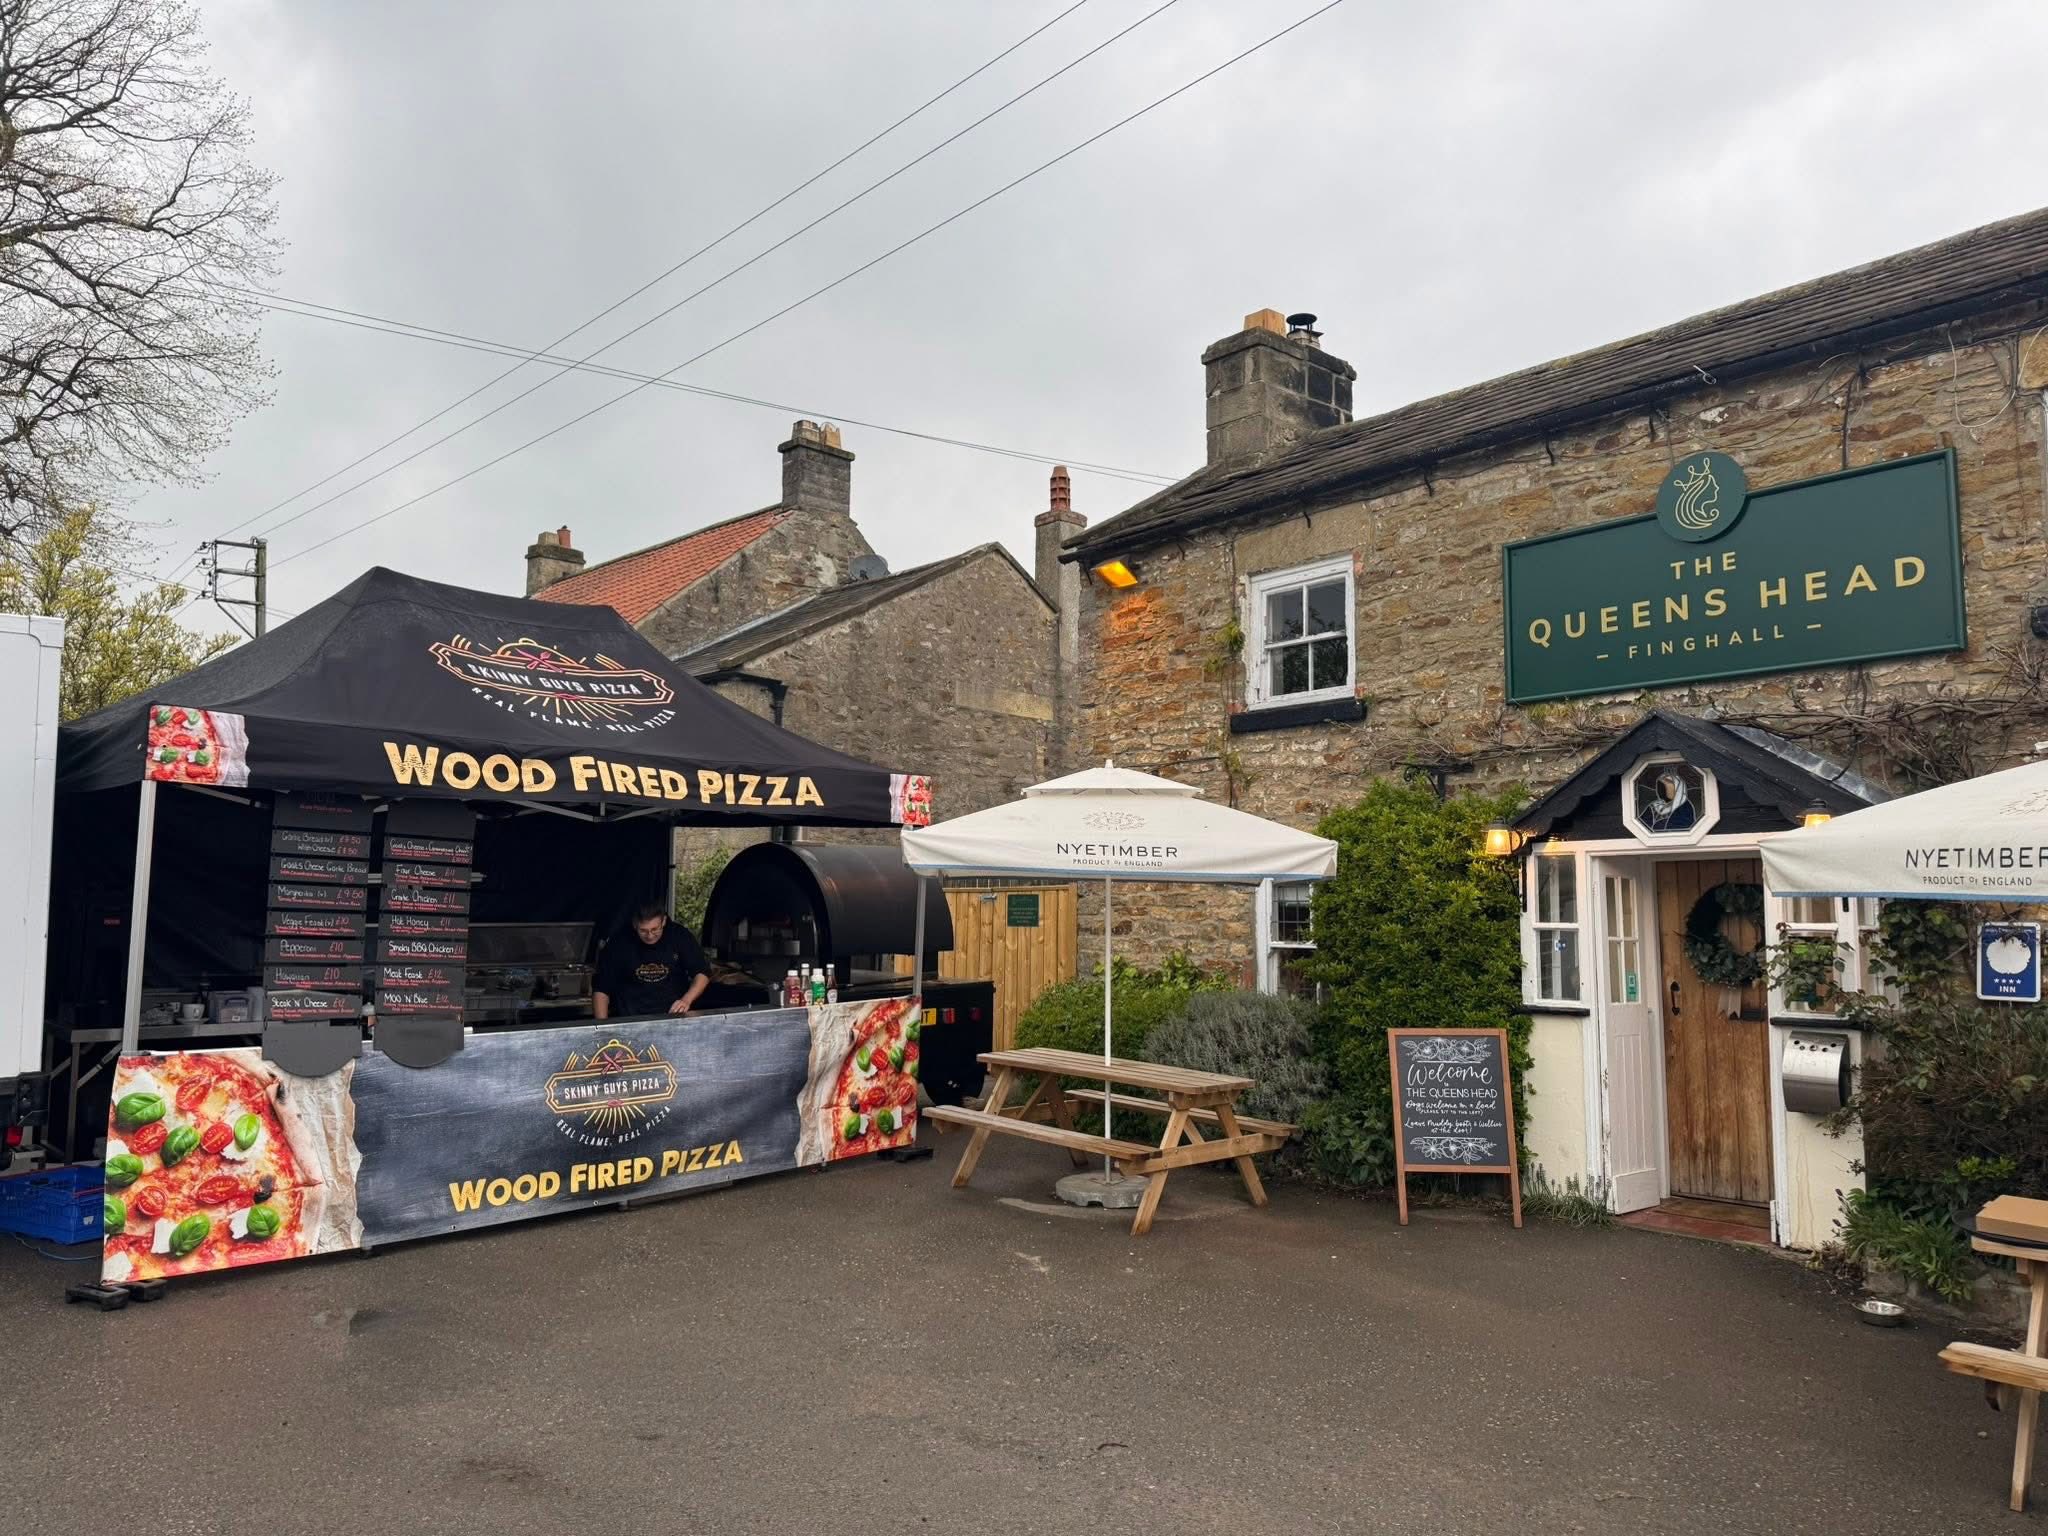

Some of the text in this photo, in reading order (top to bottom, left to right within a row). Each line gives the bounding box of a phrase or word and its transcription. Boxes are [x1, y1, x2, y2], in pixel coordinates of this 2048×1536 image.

[1669, 551, 1738, 580] THE
[1528, 555, 1927, 649] QUEENS HEAD
[1628, 624, 1785, 660] FINGHALL
[467, 662, 643, 696] SKINNY GUYS PIZZA
[471, 687, 515, 713] REAL
[605, 723, 645, 735] REAL
[643, 708, 677, 730] PIZZA
[383, 741, 825, 807] WOOD FIRED PIZZA
[1056, 843, 1178, 858] NYETIMBER
[1072, 858, 1111, 866] PRODUCT
[1124, 860, 1163, 868] ENGLAND
[1922, 876, 1965, 885] PRODUCT
[1983, 876, 2033, 886] ENGLAND
[411, 942, 427, 953] BBQ
[428, 942, 454, 954] Chicken
[1999, 985, 2016, 993] INN
[1407, 1063, 1493, 1086] Welcome
[564, 1077, 660, 1100] SKINNY GUYS PIZZA
[1406, 1087, 1498, 1099] THE QUEENS HEAD
[556, 1119, 576, 1139] REAL
[618, 1128, 641, 1144] REAL
[646, 1105, 671, 1132] PIZZA
[449, 1139, 744, 1213] WOOD FIRED PIZZA
